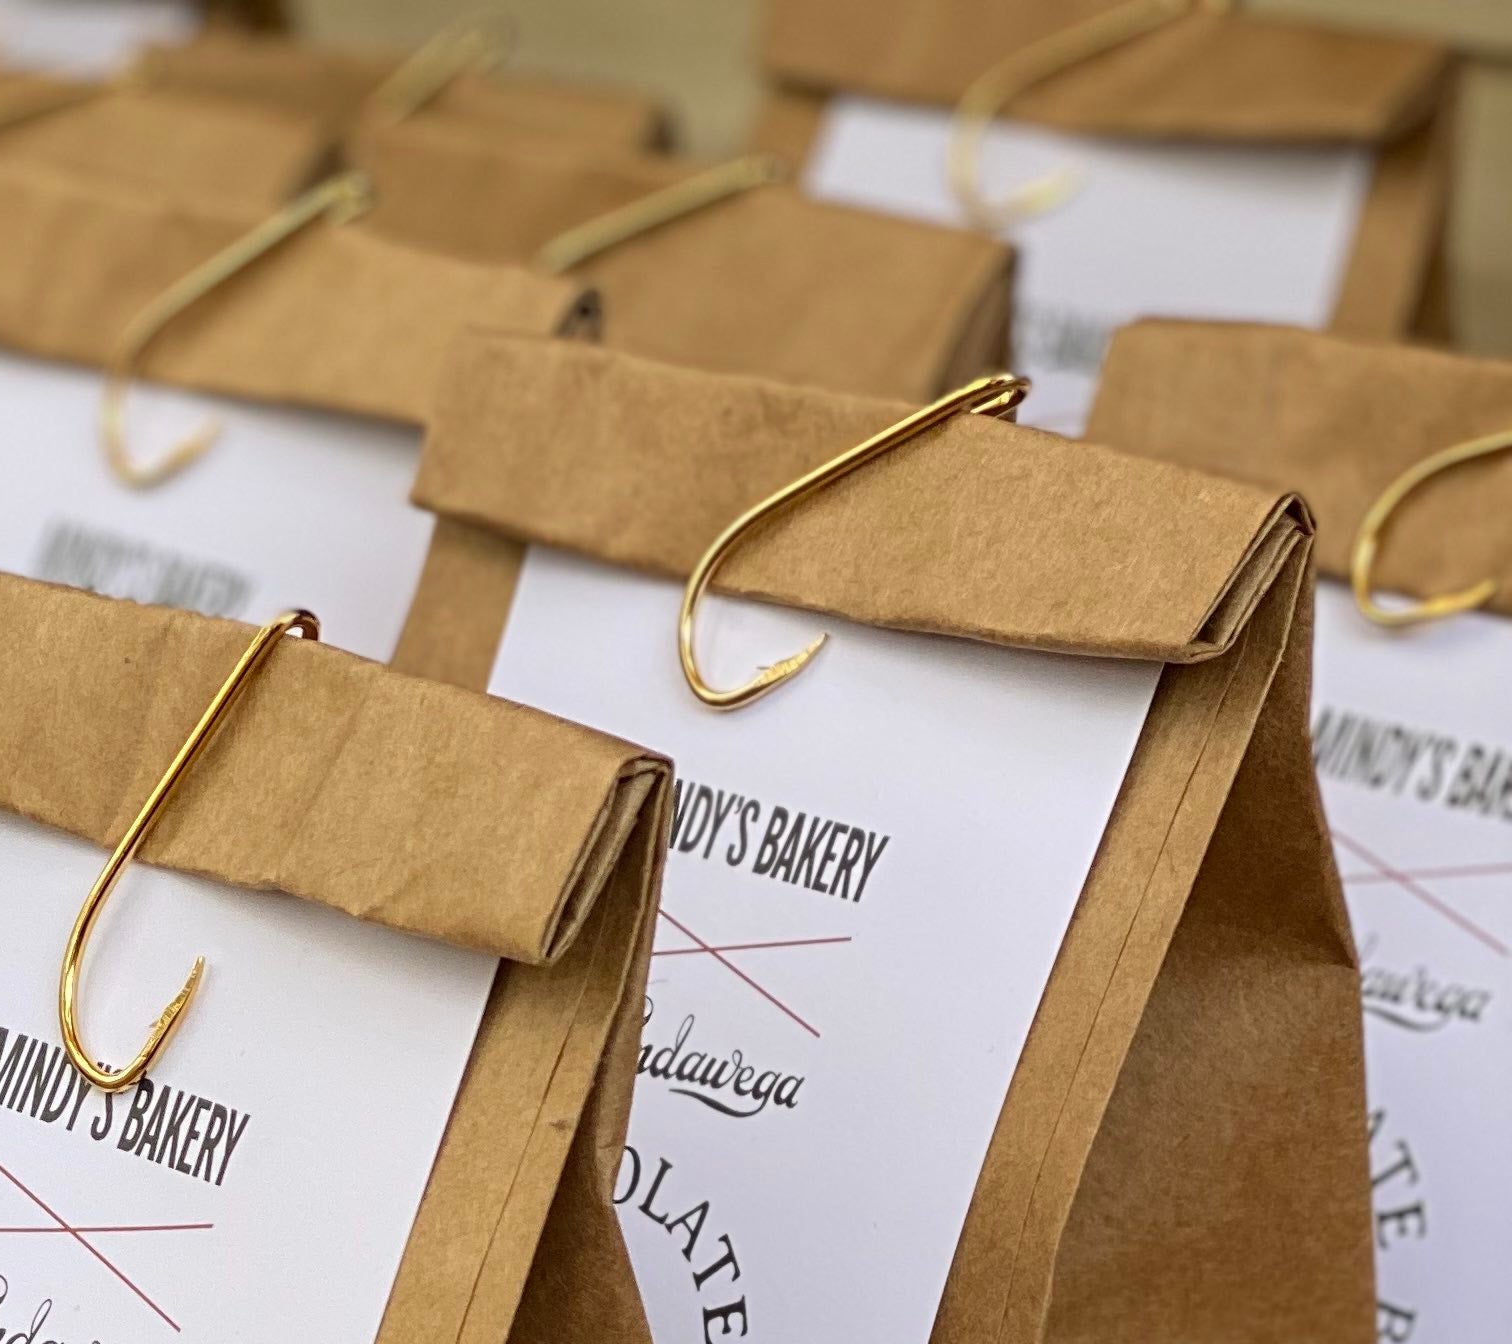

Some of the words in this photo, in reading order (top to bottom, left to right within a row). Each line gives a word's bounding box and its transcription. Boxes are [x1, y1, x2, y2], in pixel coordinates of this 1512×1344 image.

[669, 778, 760, 867] NDY'S
[752, 805, 891, 903] BAKERY
[116, 1072, 251, 1186] BAKERY
